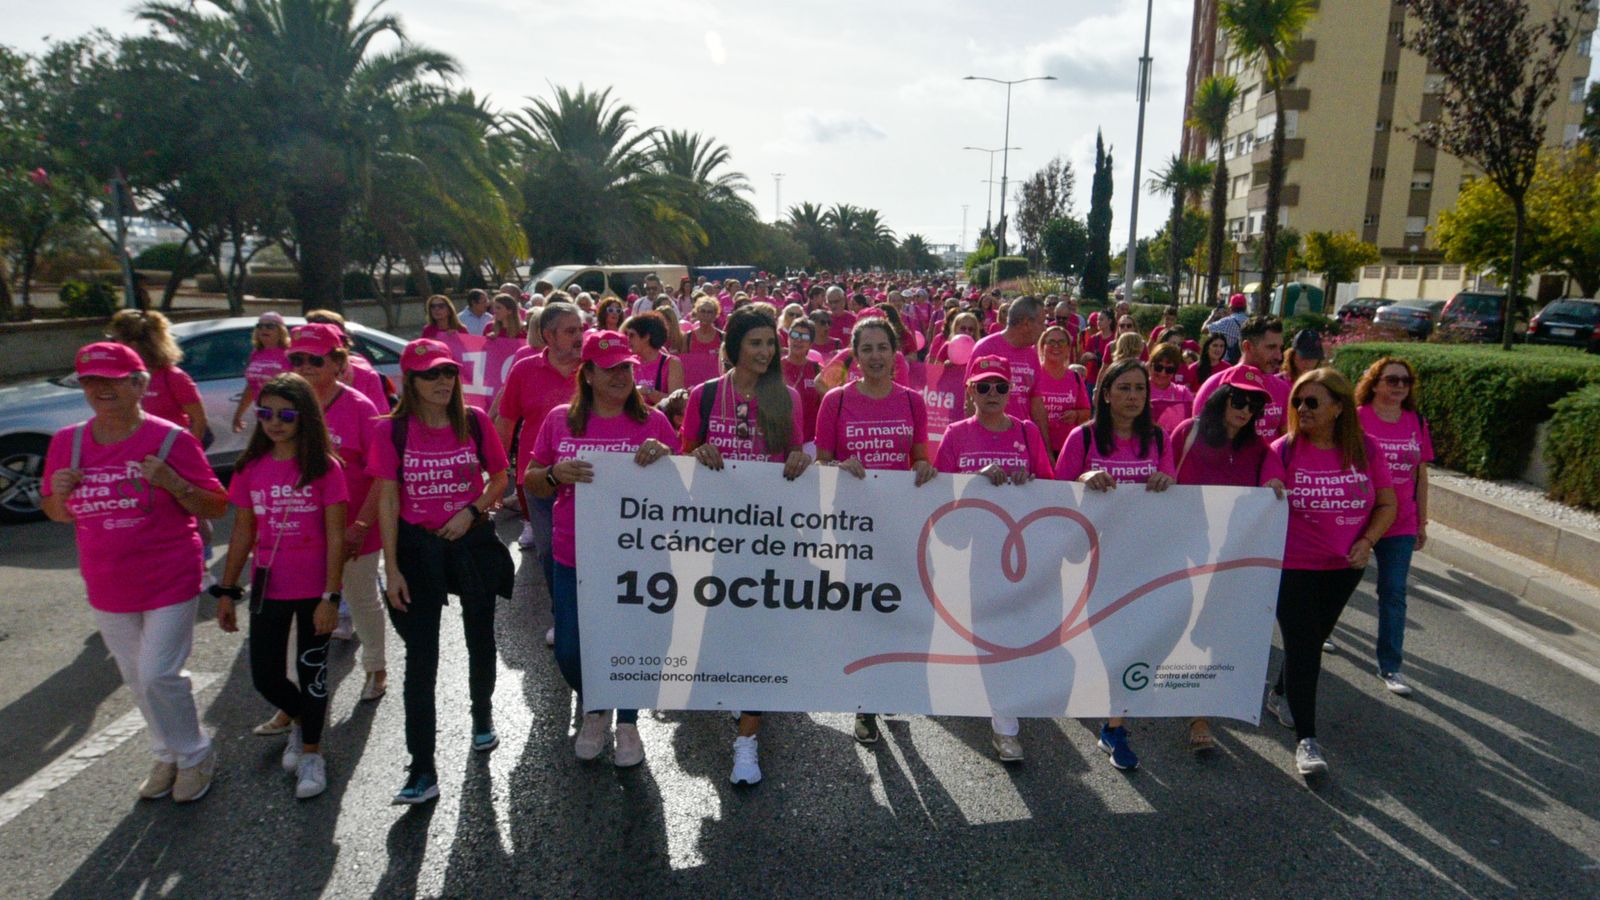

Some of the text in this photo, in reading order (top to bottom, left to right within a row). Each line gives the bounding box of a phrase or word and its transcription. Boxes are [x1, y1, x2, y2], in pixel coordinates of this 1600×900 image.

[709, 420, 726, 433] En
[846, 425, 865, 438] En
[558, 441, 577, 453] En
[708, 435, 754, 450] contra
[846, 437, 894, 451] contra
[959, 456, 975, 468] En
[1295, 471, 1312, 485] En
[418, 481, 472, 496] cáncer
[1292, 485, 1345, 497] contra
[71, 498, 139, 514] cáncer
[1292, 497, 1367, 510] el cáncer
[619, 497, 874, 532] Día mundial contra
[617, 528, 874, 561] el cáncer de mama
[616, 568, 902, 615] 19 octubre
[610, 656, 688, 668] 900 100 036
[609, 670, 789, 685] asociacioncontraelcancer.es
[1190, 672, 1216, 680] cáncer
[1165, 681, 1200, 689] Algeciras
